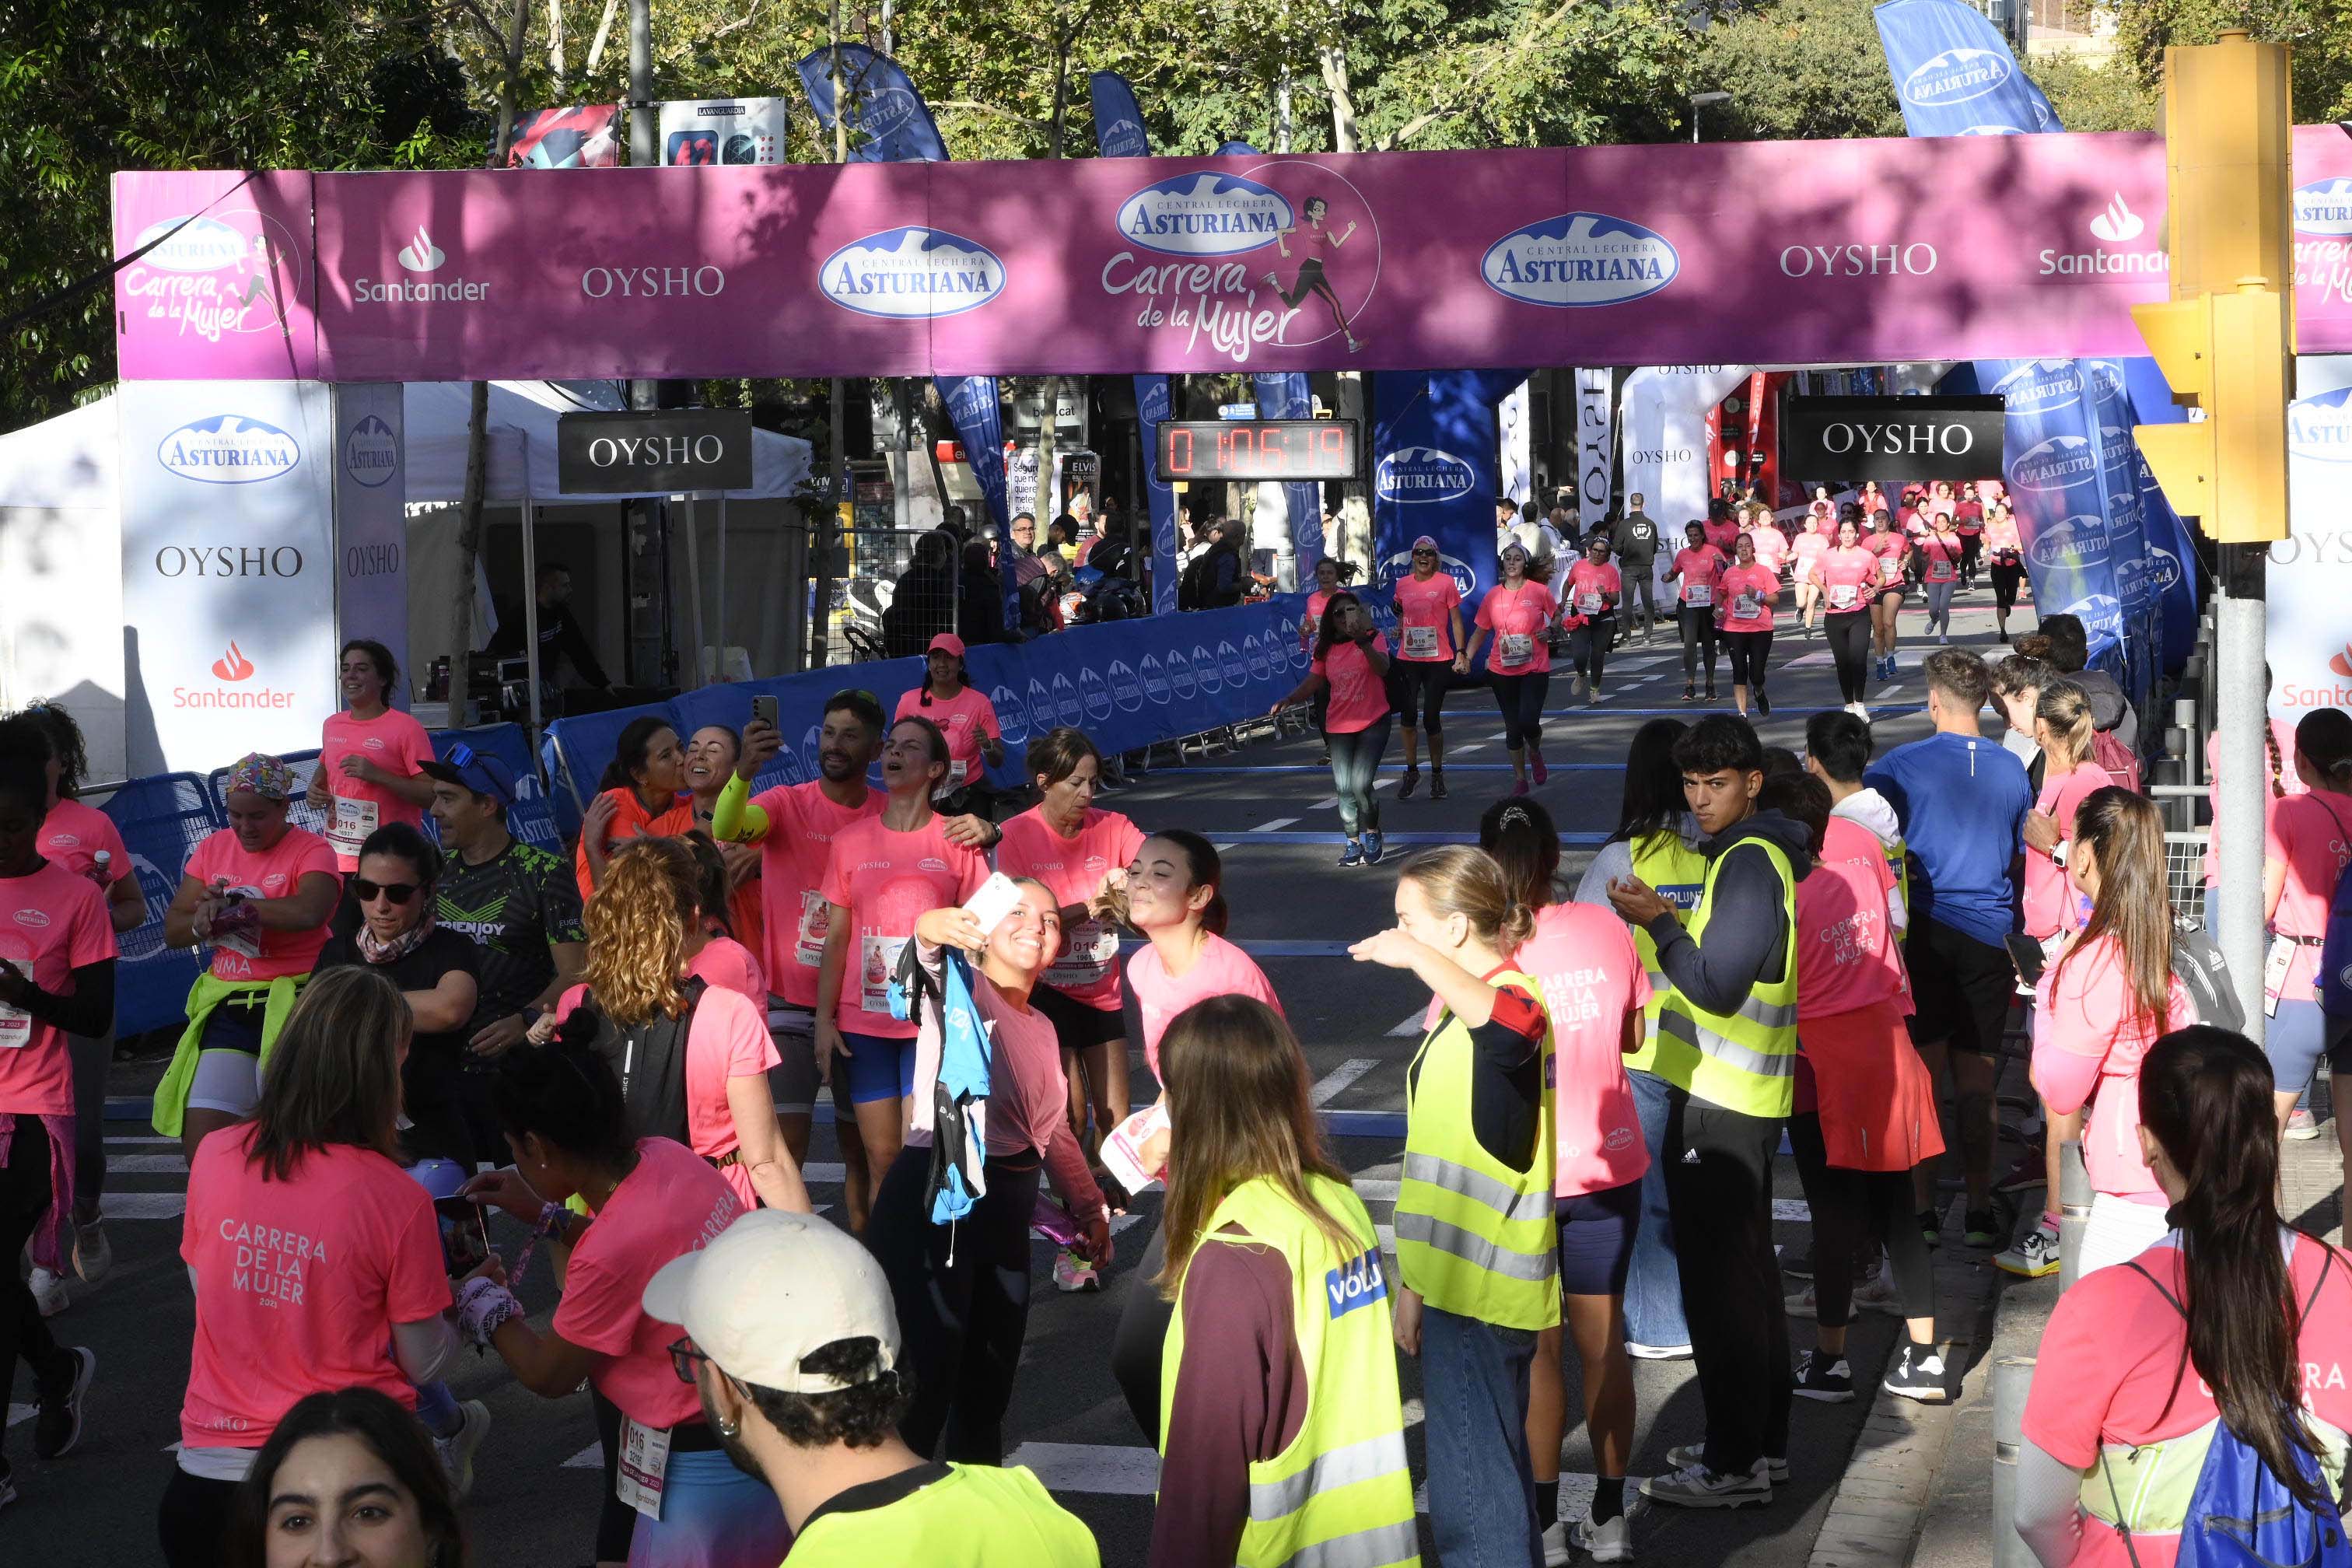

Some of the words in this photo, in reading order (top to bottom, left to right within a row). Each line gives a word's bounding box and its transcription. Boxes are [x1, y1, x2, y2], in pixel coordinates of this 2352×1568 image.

[1157, 200, 1214, 210] CENTRAL
[1218, 199, 1275, 208] LECHERA
[1130, 203, 1279, 236] ASTURIANA
[862, 258, 922, 268] CENTRAL
[926, 256, 987, 266] LECHERA
[1526, 244, 1588, 255] CENTRAL
[1593, 243, 1657, 254] LECHERA
[1780, 242, 1937, 278] OYSHO
[832, 261, 992, 296] ASTURIANA
[1101, 251, 1247, 295] Carrera
[1496, 249, 1664, 284] ASTURIANA
[124, 267, 218, 297] Carrera
[355, 277, 490, 303] Santander
[581, 265, 725, 298] OYSHO
[148, 297, 166, 318] de
[168, 297, 181, 318] la
[178, 293, 253, 343] Mujer
[1137, 299, 1164, 327] de
[1170, 296, 1190, 327] la
[1185, 287, 1302, 362] Mujer
[169, 439, 292, 467] ASTURIANA
[589, 434, 723, 467] OYSHO
[1822, 423, 1973, 456] OYSHO
[1072, 463, 1096, 471] ELVIS
[1633, 449, 1692, 464] OYSHO
[1014, 485, 1038, 495] quiere
[1379, 470, 1468, 492] ASTURIANA
[1636, 527, 1647, 535] BP
[156, 546, 303, 578] OYSHO
[346, 543, 399, 578] OYSHO
[173, 687, 295, 709] Santander
[338, 819, 356, 830] 016
[857, 861, 891, 872] OYSHO
[1031, 862, 1064, 871] OYSHO
[558, 918, 579, 929] EUGE
[1820, 908, 1878, 943] CARRERA
[1073, 940, 1099, 952] 016
[1834, 935, 1852, 950] DE
[1855, 926, 1871, 942] LA
[1835, 937, 1877, 965] MUJER
[1076, 954, 1096, 962] 19613
[1542, 967, 1608, 990] ARRERA
[1546, 992, 1569, 1009] DE
[1573, 988, 1595, 1003] LA
[692, 1188, 737, 1251] CARRERA
[219, 1218, 327, 1264] CARRERA
[236, 1244, 269, 1270] DE
[275, 1257, 303, 1281] LA
[233, 1270, 304, 1305] MUJER
[629, 1427, 645, 1450] 016
